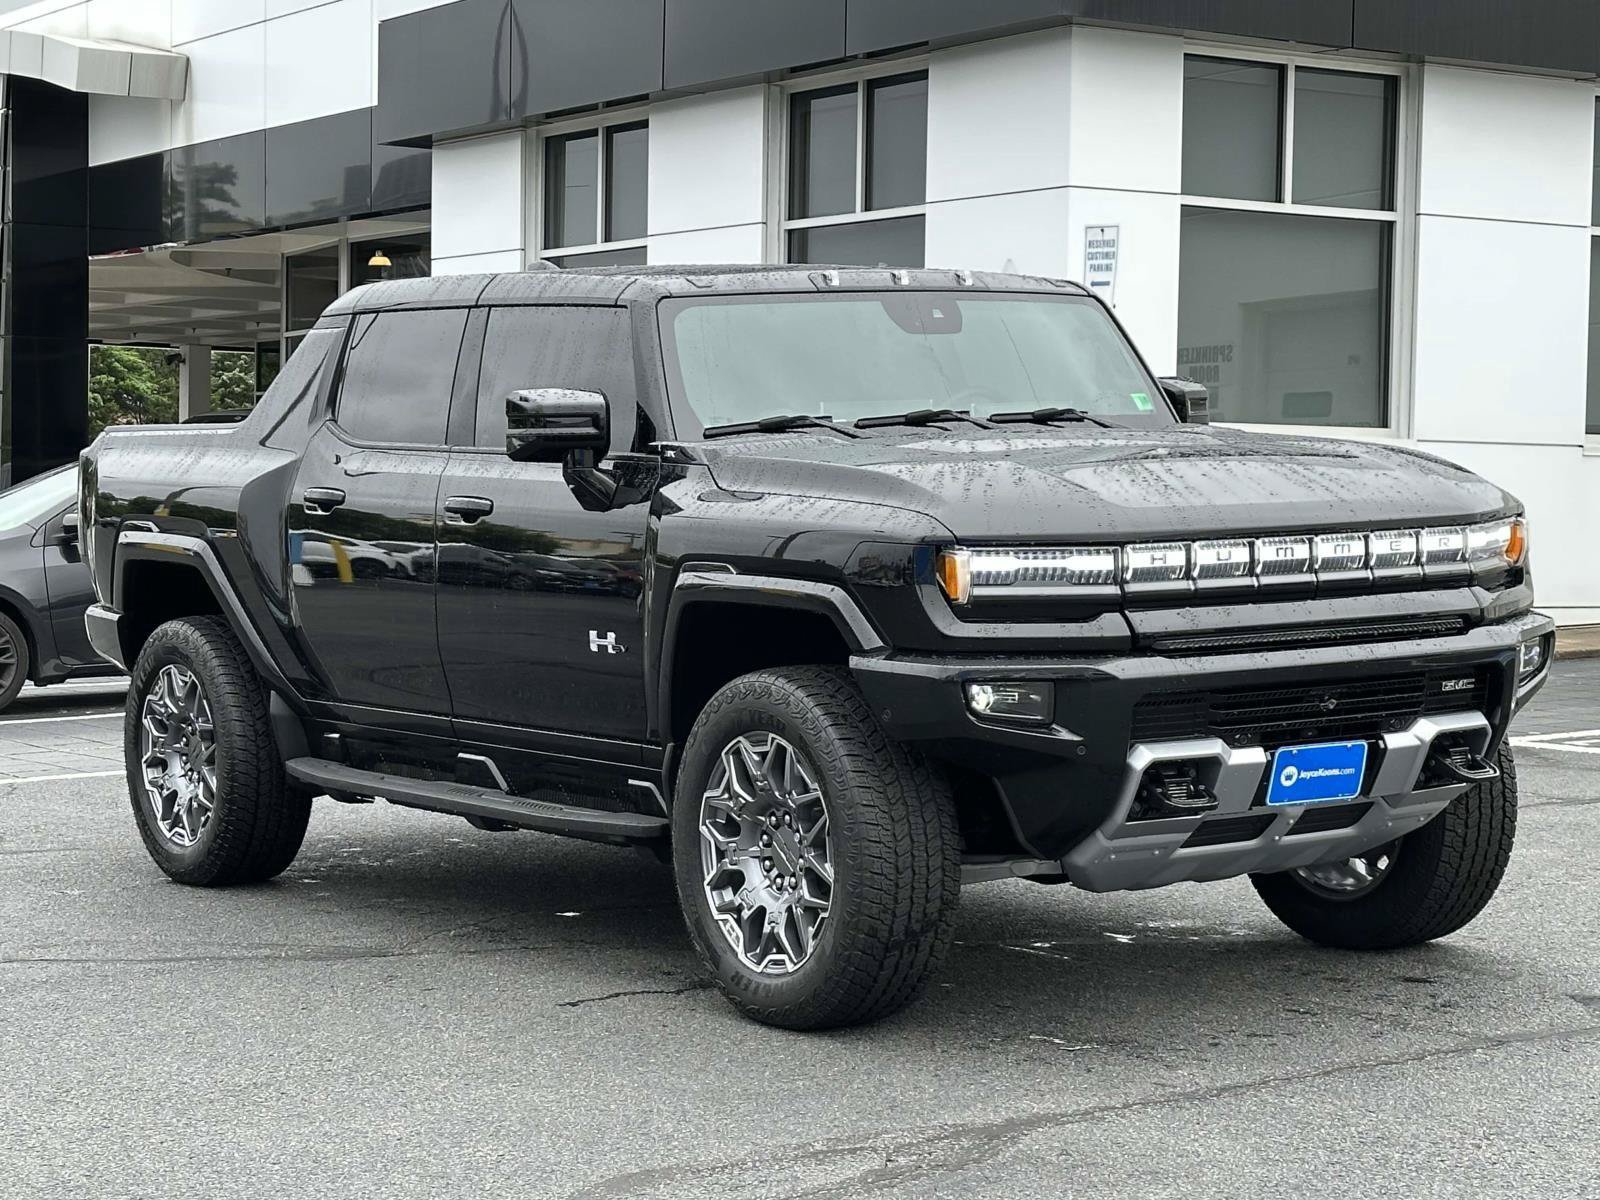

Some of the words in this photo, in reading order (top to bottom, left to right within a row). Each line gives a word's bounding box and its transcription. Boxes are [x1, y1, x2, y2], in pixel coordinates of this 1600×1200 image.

[1088, 239, 1115, 248] RESERVED
[1087, 251, 1115, 261] CUSTOMER
[1089, 262, 1113, 272] PARKING
[1149, 536, 1449, 565] HUMMER
[1442, 678, 1475, 692] GMC
[1299, 768, 1356, 780] JoyceKoons.com
